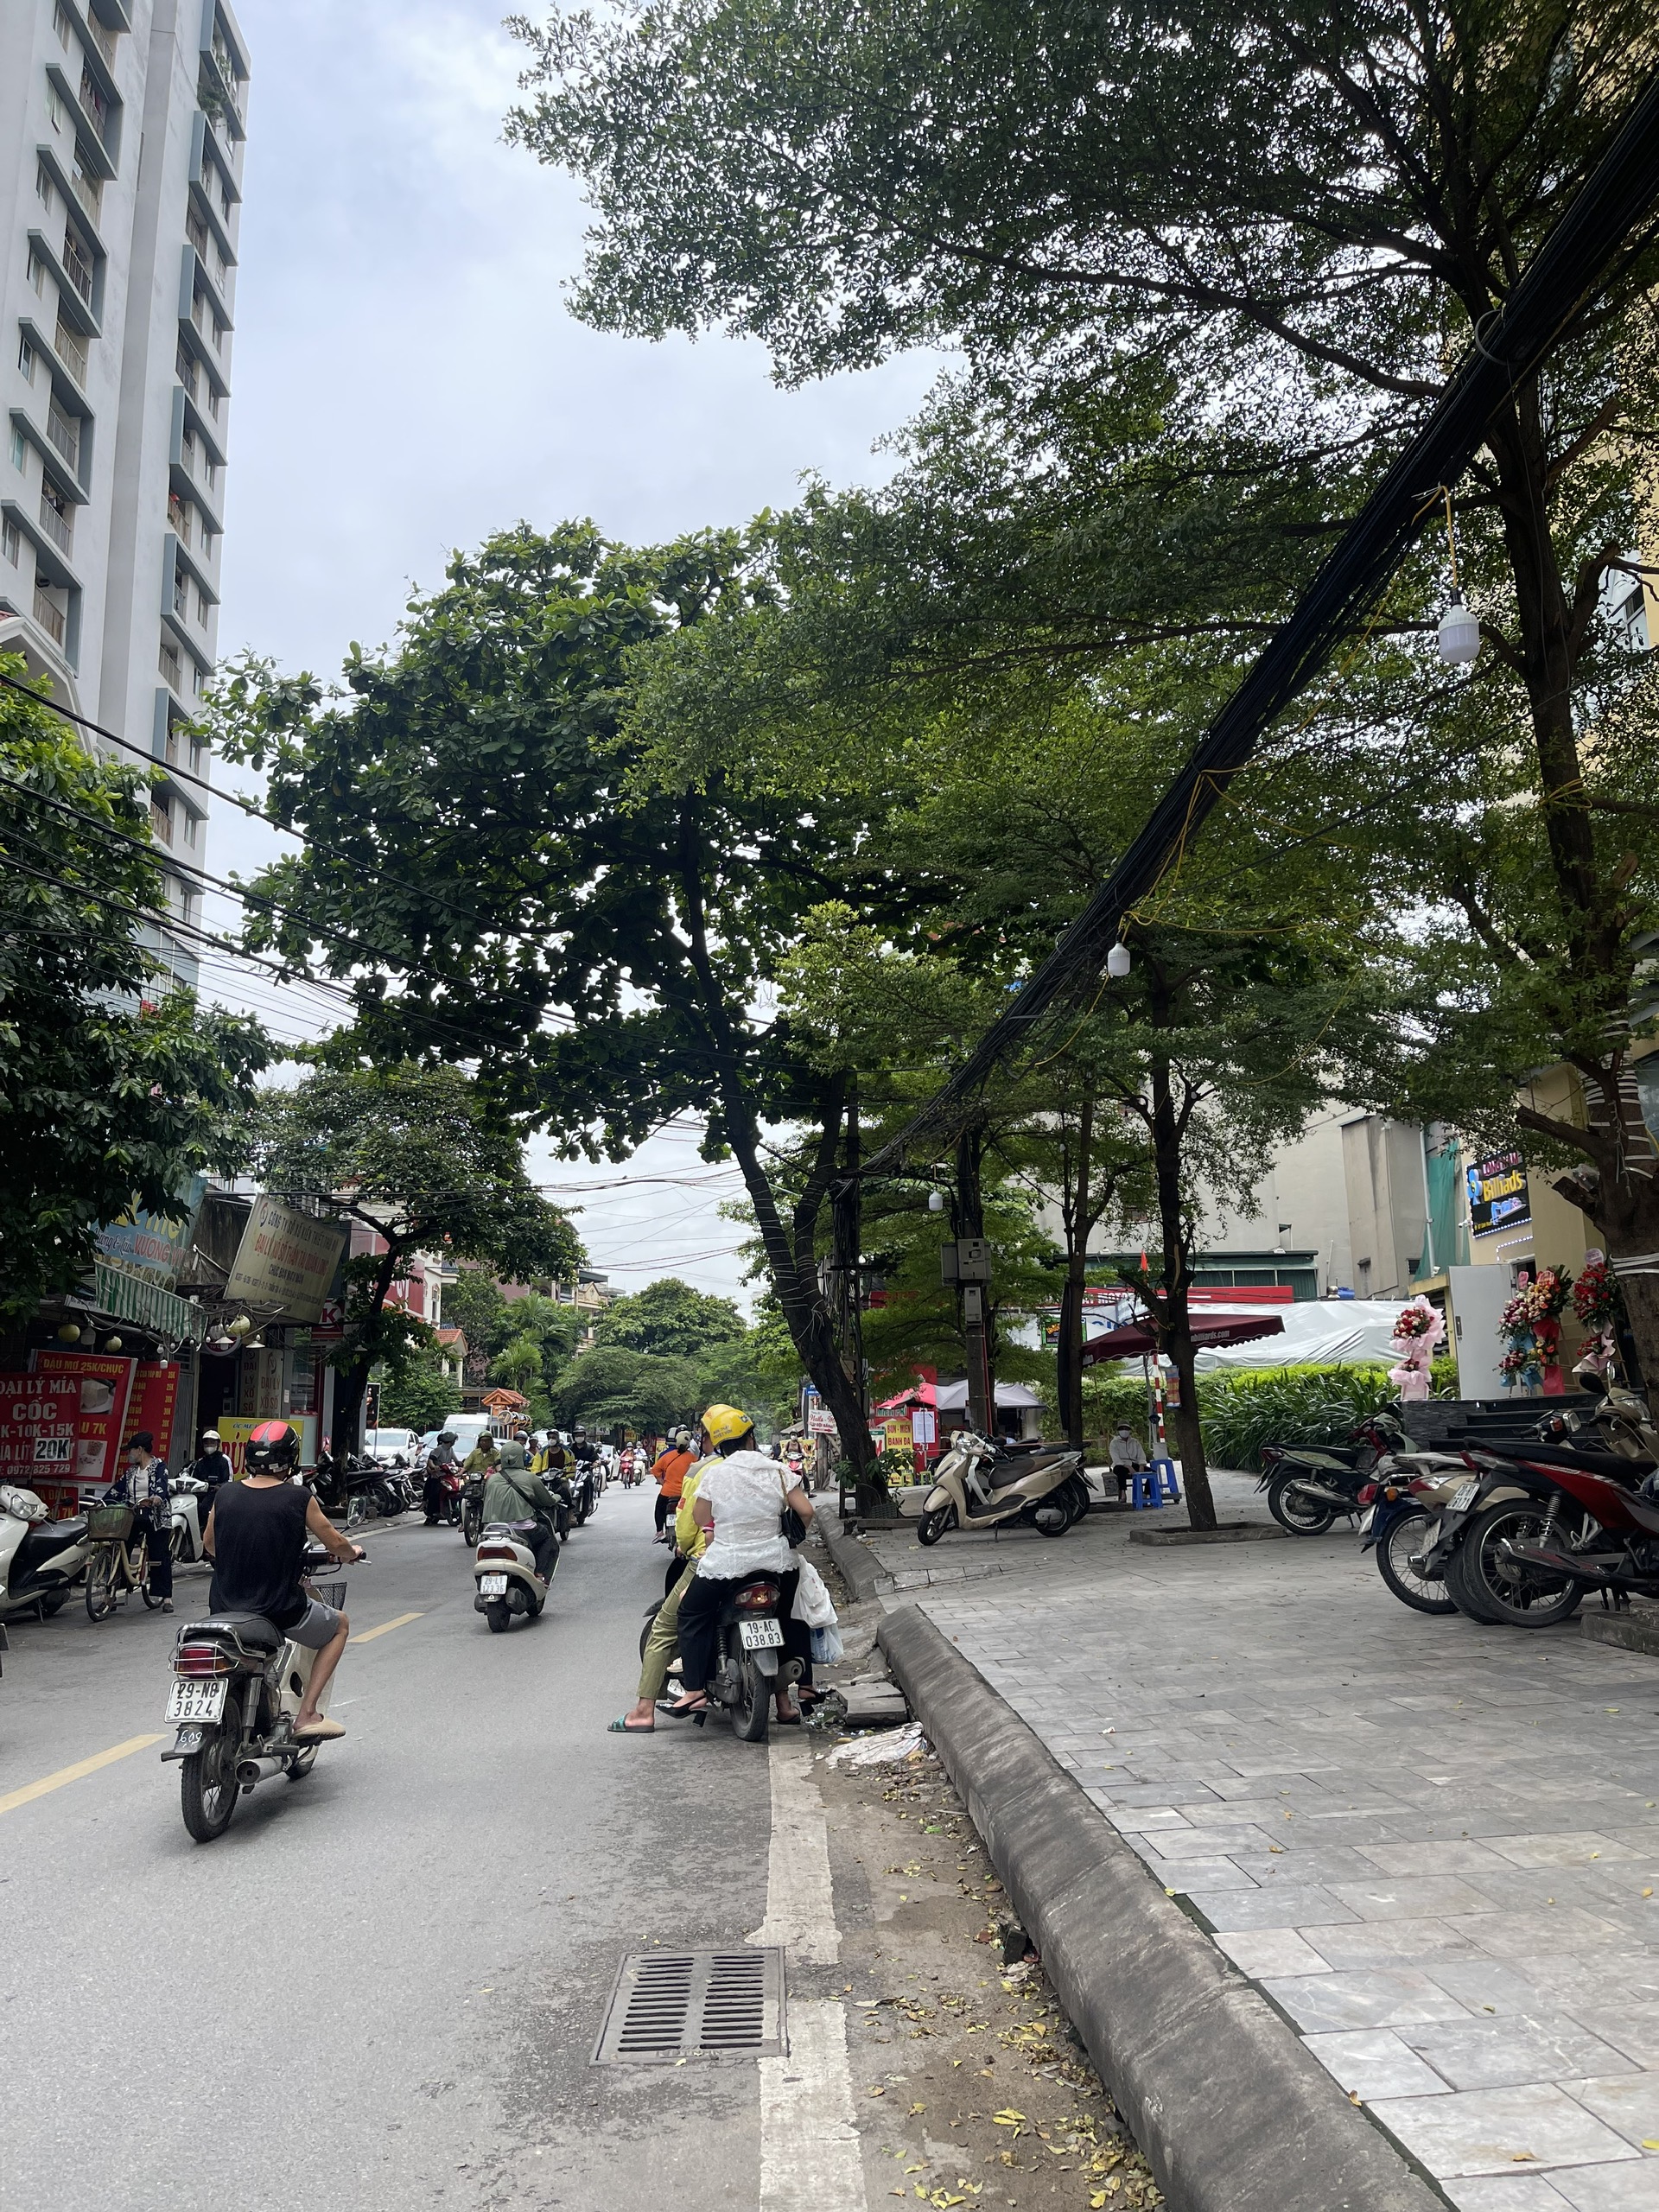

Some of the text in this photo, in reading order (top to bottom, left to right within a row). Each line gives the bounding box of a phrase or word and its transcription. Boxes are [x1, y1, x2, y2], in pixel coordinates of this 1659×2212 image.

[243, 1362, 257, 1373] ĐẠI
[27, 1376, 46, 1395] LÝ
[49, 1376, 77, 1394] MÍA
[245, 1375, 255, 1384] LÝ
[261, 1375, 281, 1391] ĐẠI LÝ
[243, 1399, 255, 1412] SỐ
[260, 1392, 279, 1409] XỔ SỐ
[12, 1397, 58, 1421] CỐC
[92, 1422, 107, 1435] 7K
[35, 1440, 69, 1459] 20K
[7, 1465, 33, 1475] 0972
[33, 1465, 51, 1475] 825
[54, 1464, 71, 1474] 729
[747, 1620, 775, 1635] 19-AC
[745, 1632, 781, 1648] 038.83
[174, 1700, 213, 1718] 3824
